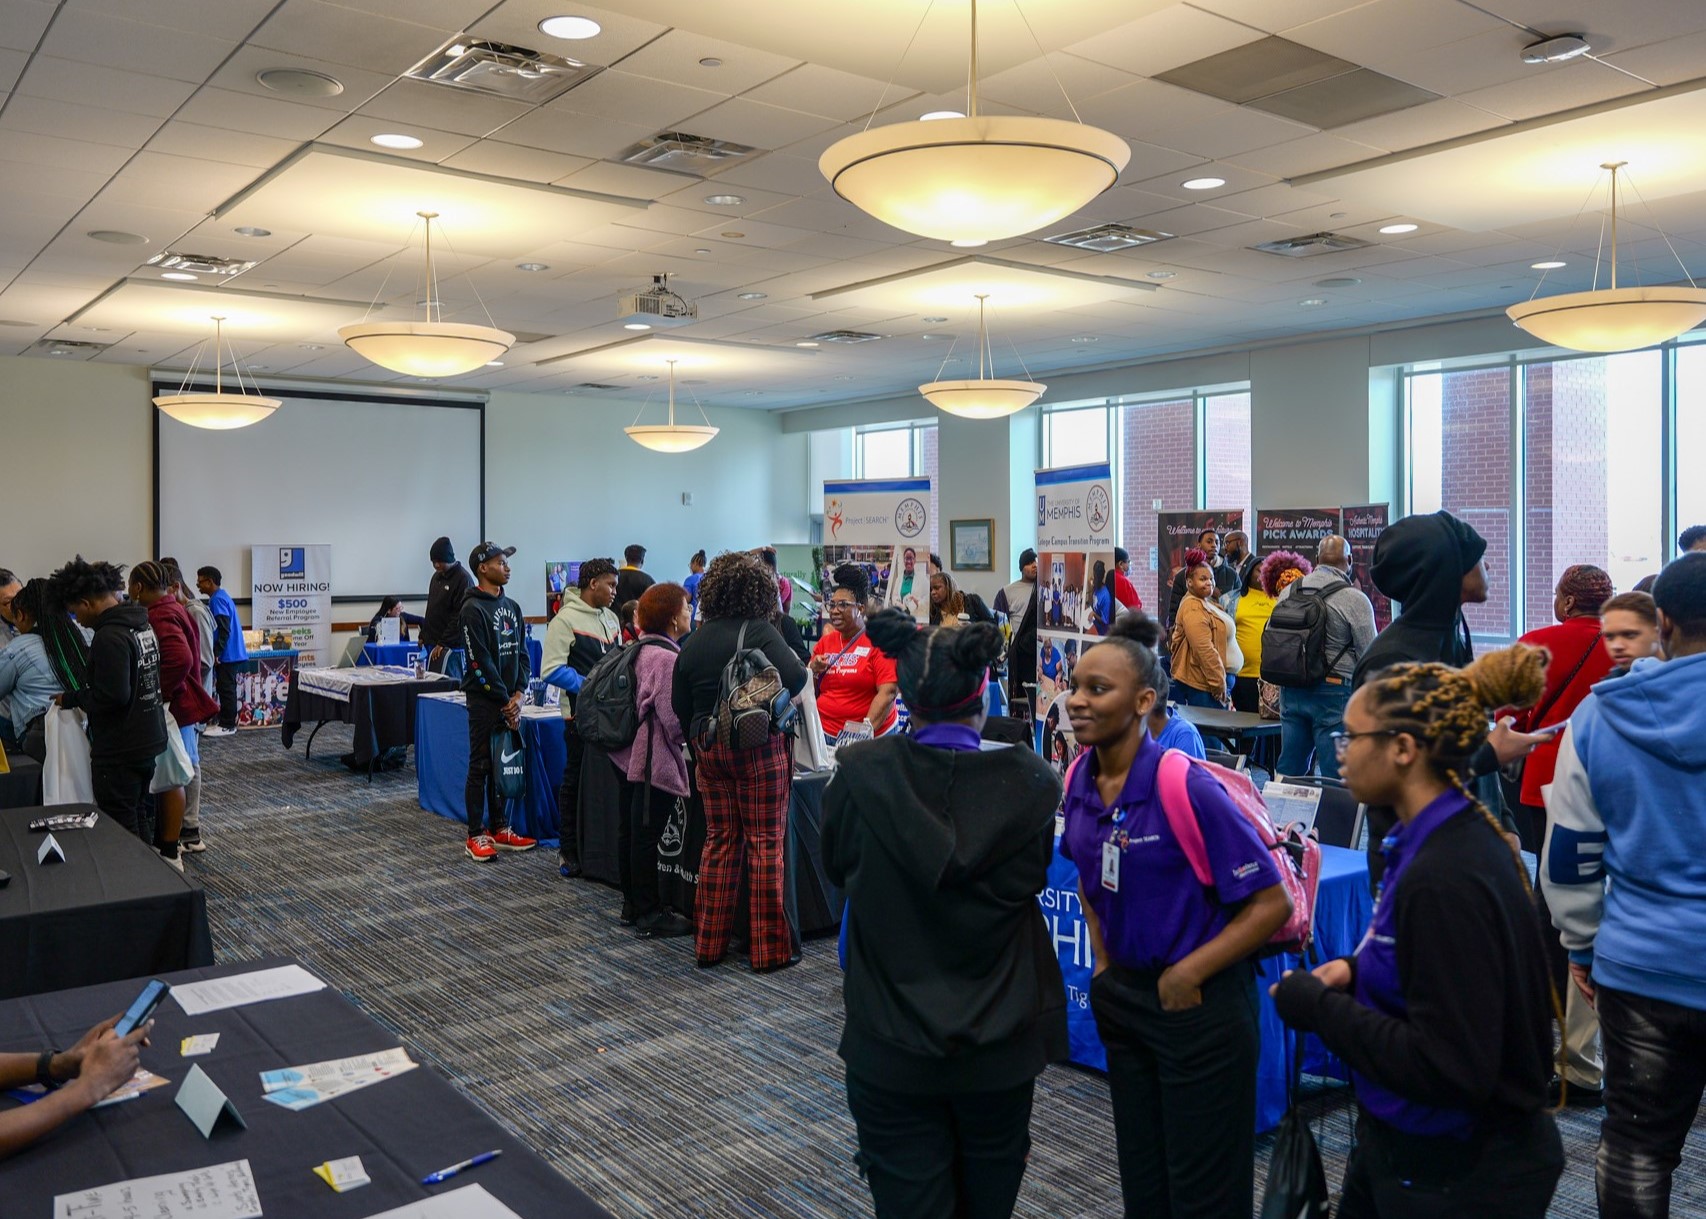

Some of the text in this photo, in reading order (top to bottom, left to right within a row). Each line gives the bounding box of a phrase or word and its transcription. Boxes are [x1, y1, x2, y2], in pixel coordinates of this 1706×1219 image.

[1047, 506, 1081, 520] MEMPHIS
[846, 516, 863, 526] Project
[1263, 516, 1333, 530] Welcome to Memphis
[1166, 524, 1195, 535] Welcome
[1263, 529, 1334, 539] PICK AWARDS
[254, 582, 330, 592] NOW HIRING!
[278, 599, 307, 609] $500
[503, 766, 513, 775] JUST
[1067, 984, 1088, 1009] Tig
